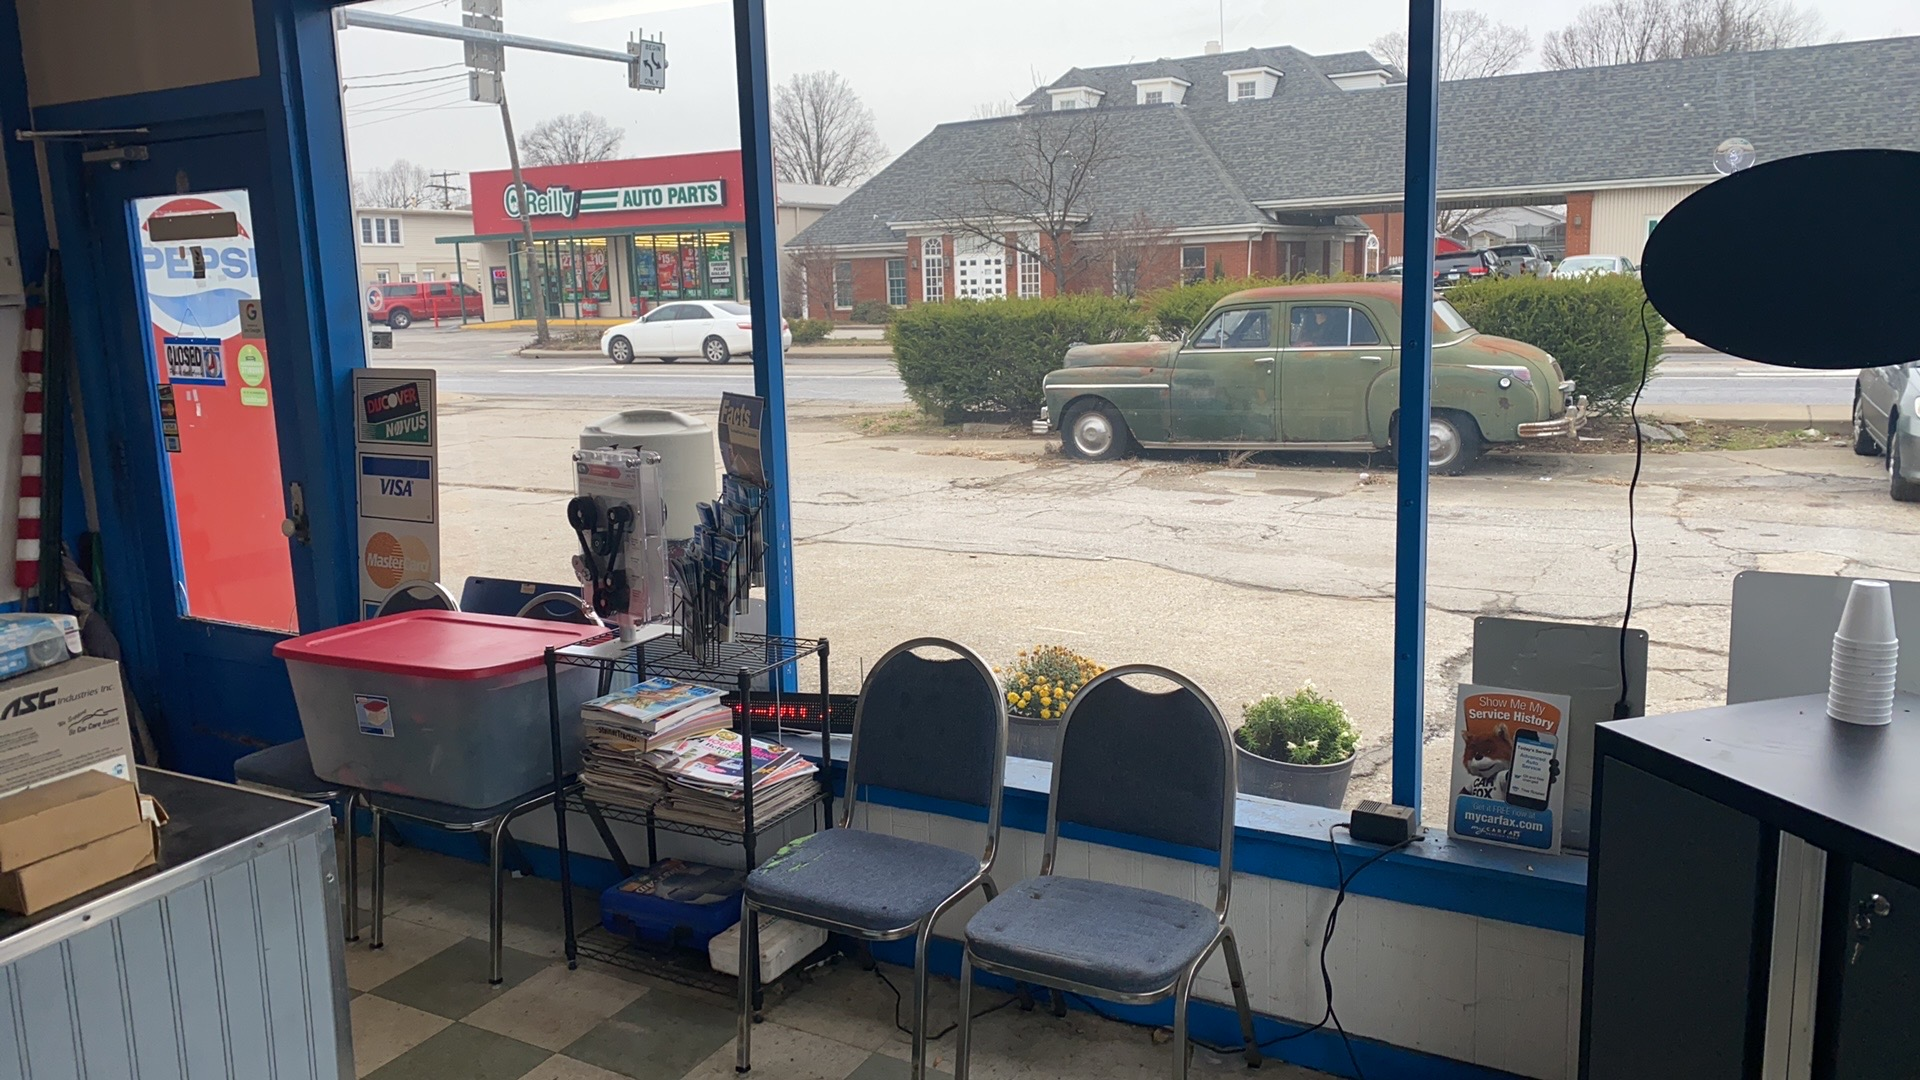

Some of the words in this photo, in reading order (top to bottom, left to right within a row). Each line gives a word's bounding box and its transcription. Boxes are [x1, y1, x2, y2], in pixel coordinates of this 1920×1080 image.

[644, 78, 659, 86] ONLY
[506, 186, 573, 216] OReilly
[623, 187, 662, 207] AUTO
[668, 184, 718, 204] PARTS
[141, 247, 259, 278] PEPSI
[246, 303, 257, 320] G
[167, 346, 202, 366] CLOSED
[366, 387, 418, 414] DISCOVER
[720, 399, 752, 428] Facts
[386, 414, 427, 438] NOVUS
[380, 478, 413, 496] VISA
[0, 687, 58, 720] ASC
[57, 688, 99, 705] Industries
[1479, 696, 1507, 708] Show
[1510, 699, 1526, 709] Me
[1529, 702, 1546, 715] My
[1468, 708, 1510, 720] Service
[1513, 711, 1554, 730] History
[1473, 788, 1493, 799] FOX
[1473, 802, 1485, 811] Get
[1486, 803, 1492, 812] it
[1492, 805, 1510, 815] FREE
[1512, 808, 1527, 818] now
[1465, 811, 1543, 831] mycarfax.com
